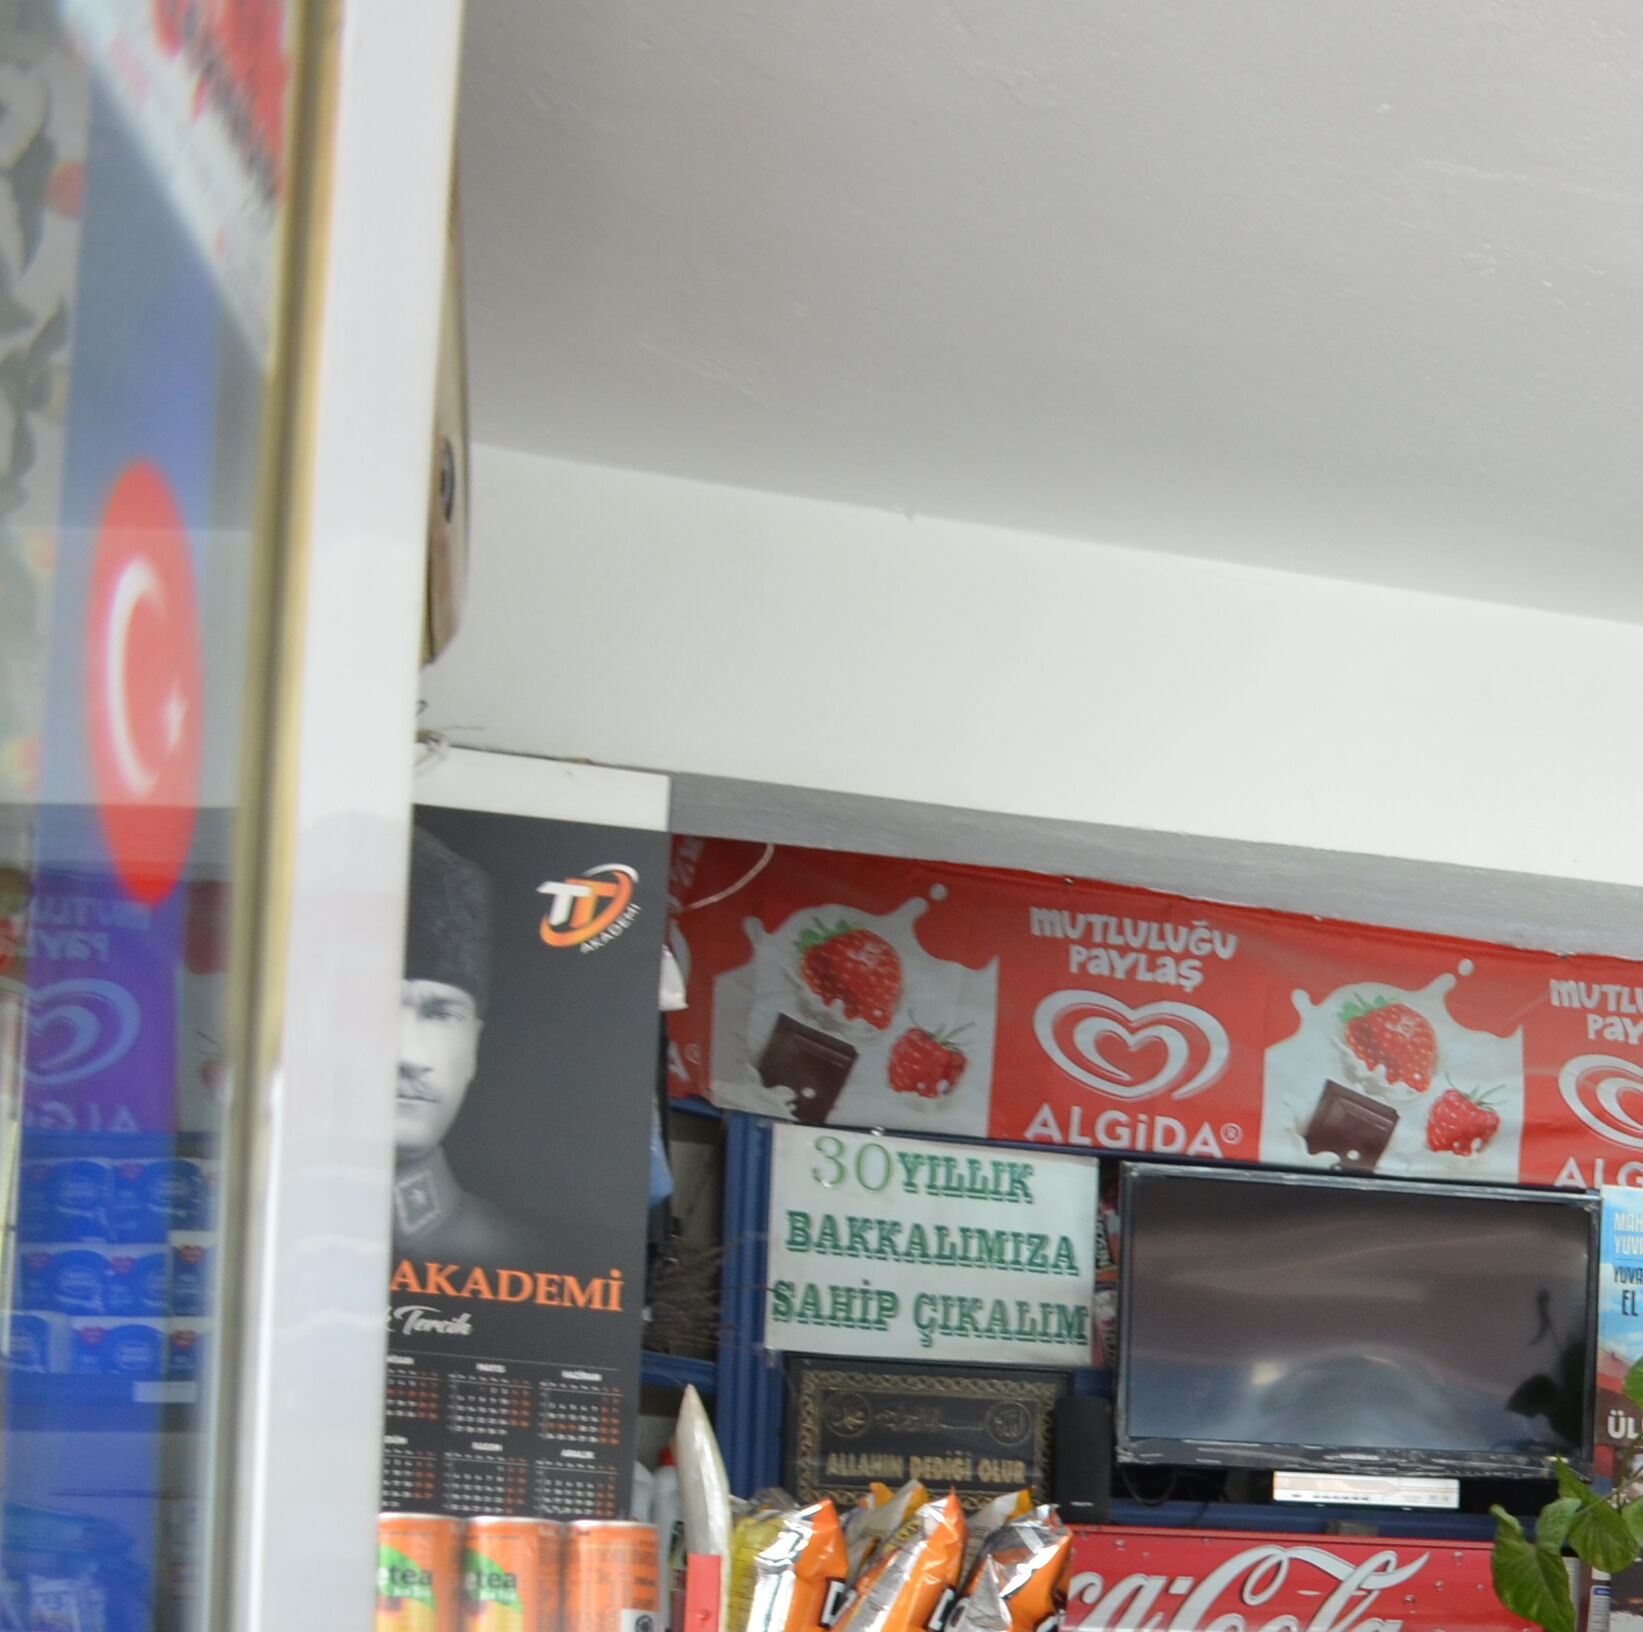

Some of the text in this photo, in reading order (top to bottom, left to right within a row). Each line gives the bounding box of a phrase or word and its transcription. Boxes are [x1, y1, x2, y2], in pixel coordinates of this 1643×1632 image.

[785, 1211, 1079, 1277] BAKKALIMIZA
[390, 1259, 624, 1313] AKADEMİ
[770, 1279, 1091, 1349] SAHİP ÇIKALIM
[1622, 1290, 1638, 1316] EL
